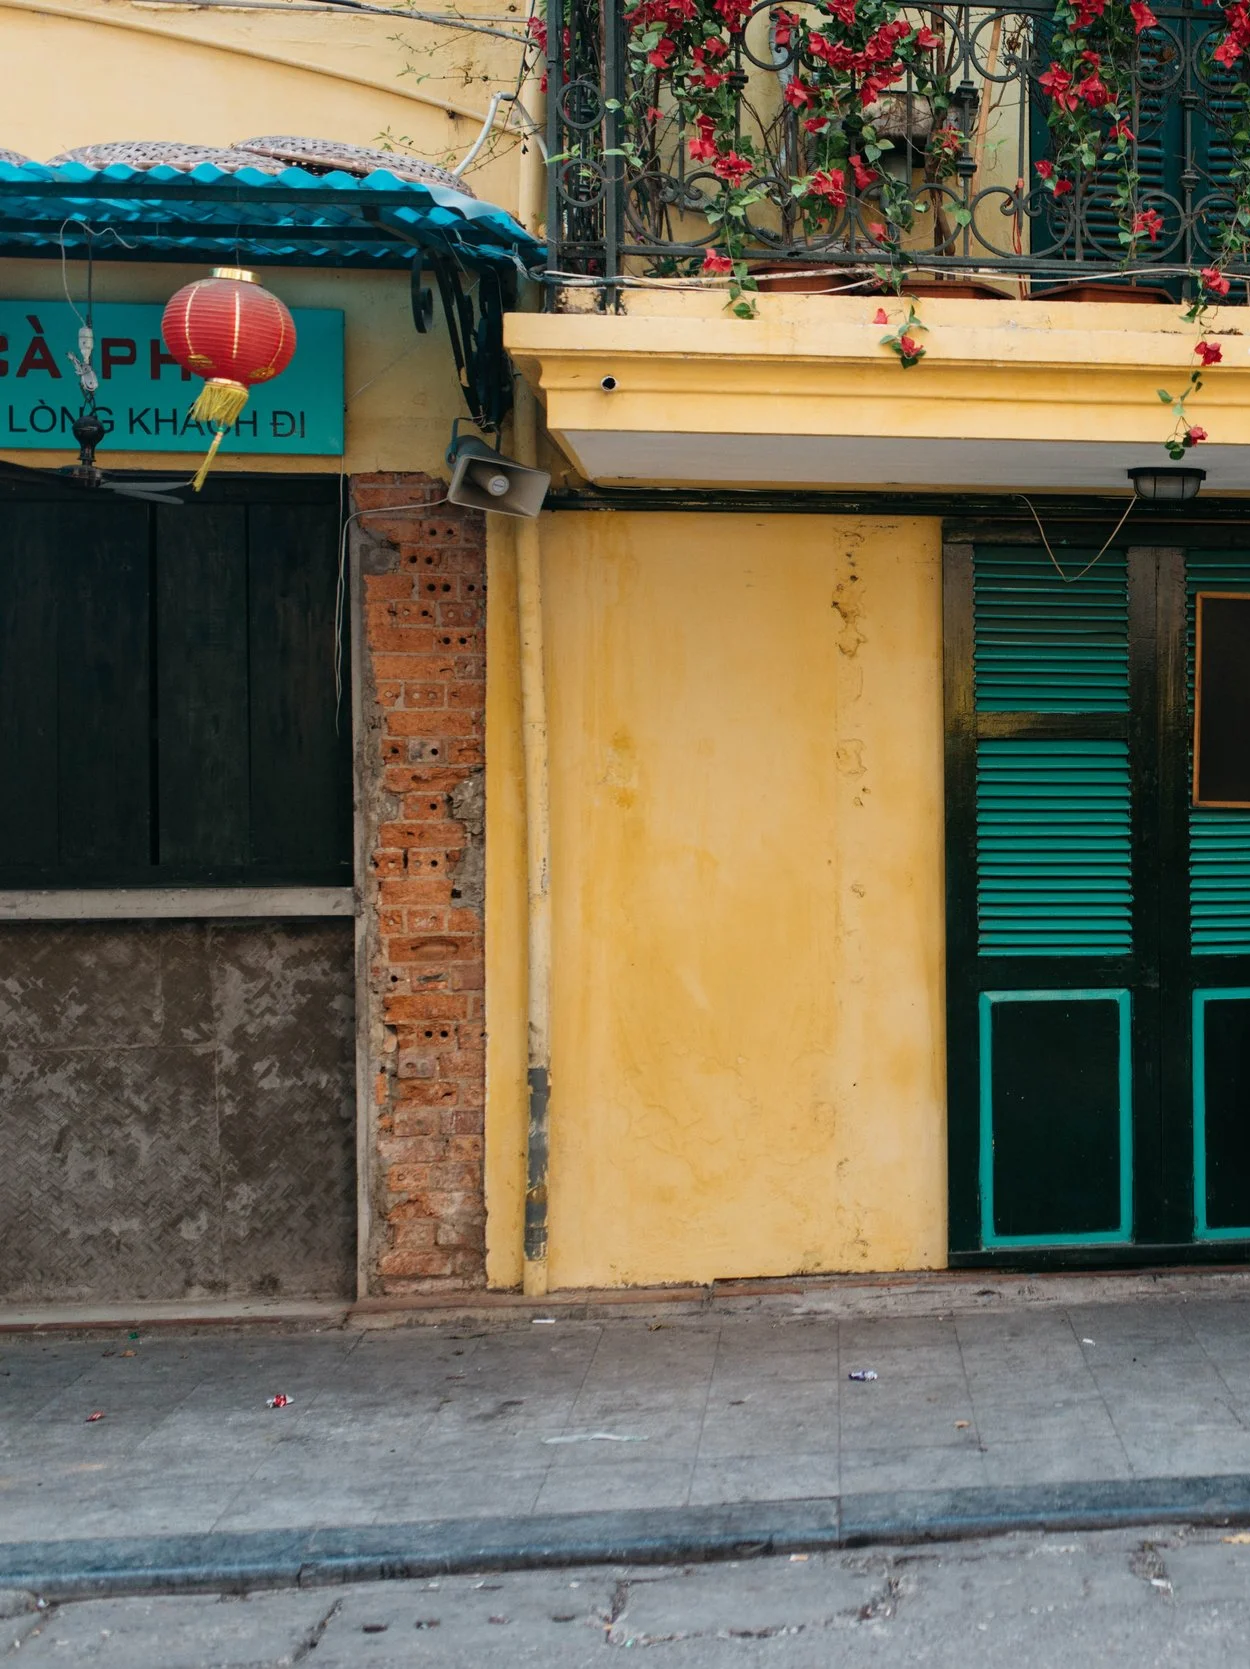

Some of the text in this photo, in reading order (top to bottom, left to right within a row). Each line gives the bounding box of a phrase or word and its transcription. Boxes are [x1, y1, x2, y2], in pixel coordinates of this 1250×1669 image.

[0, 314, 63, 379] À
[8, 399, 115, 434] LÒNG
[270, 410, 305, 439] ĐI
